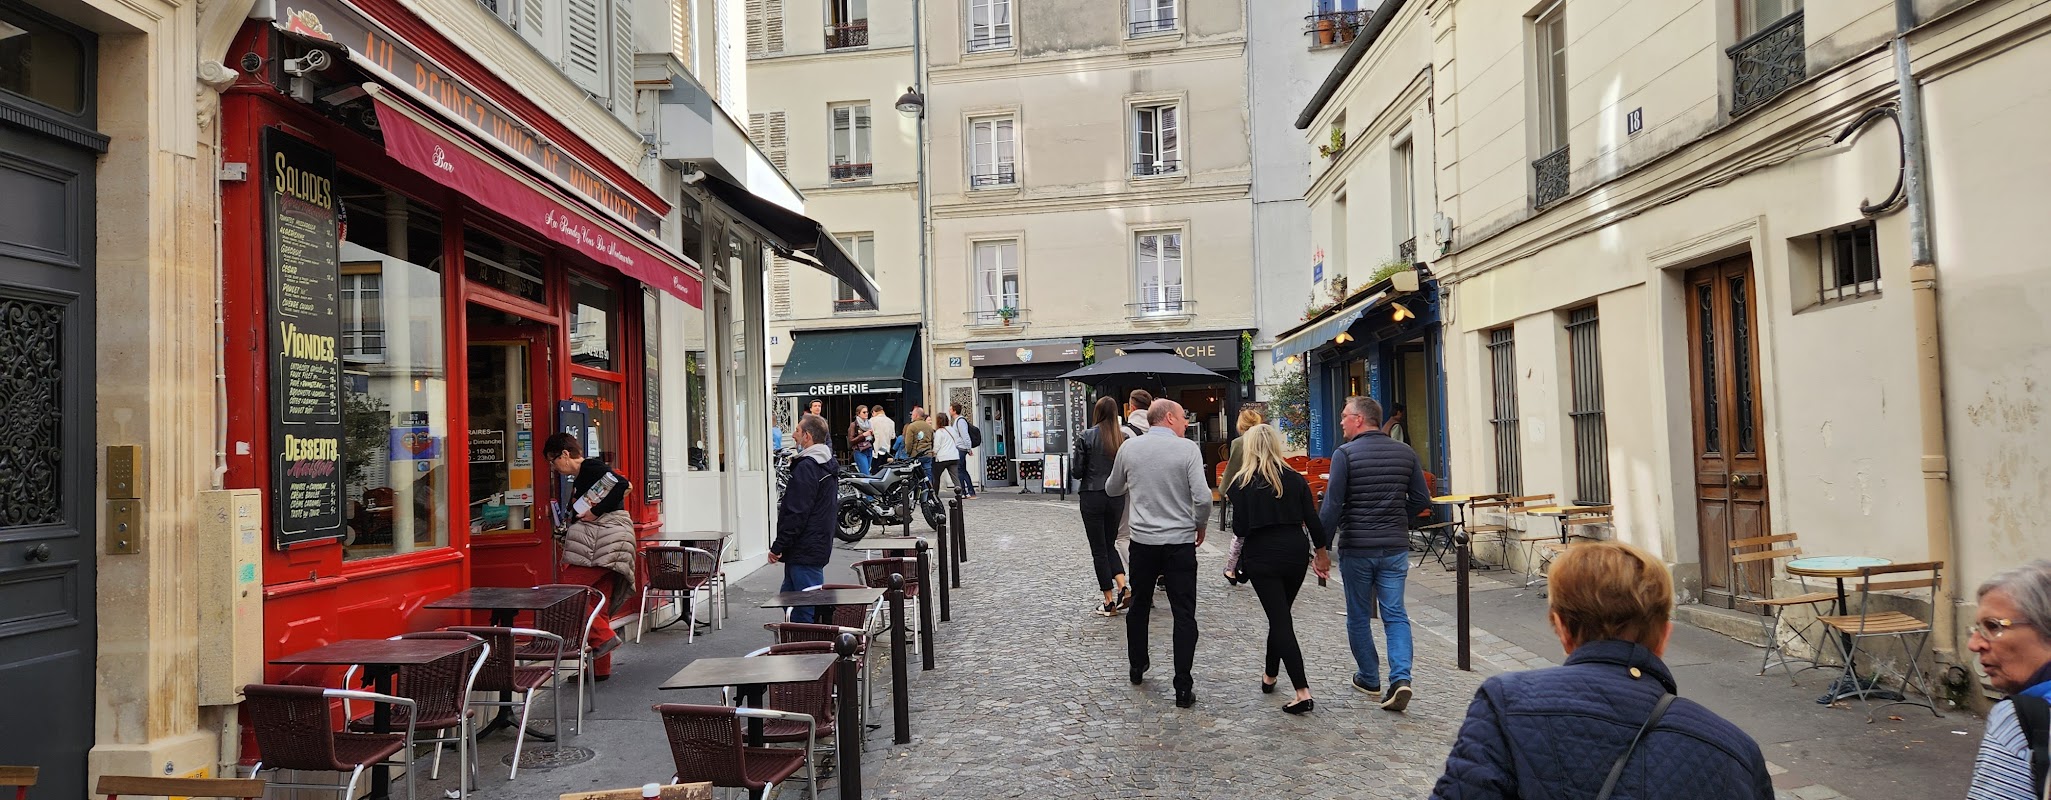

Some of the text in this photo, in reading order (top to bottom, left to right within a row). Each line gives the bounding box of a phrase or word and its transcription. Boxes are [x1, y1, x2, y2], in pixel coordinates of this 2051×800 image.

[1629, 110, 1641, 133] 18
[432, 144, 455, 173] Bar
[951, 357, 961, 367] 22
[809, 383, 869, 396] CRÊPERIE
[285, 434, 337, 462] DESSERTS
